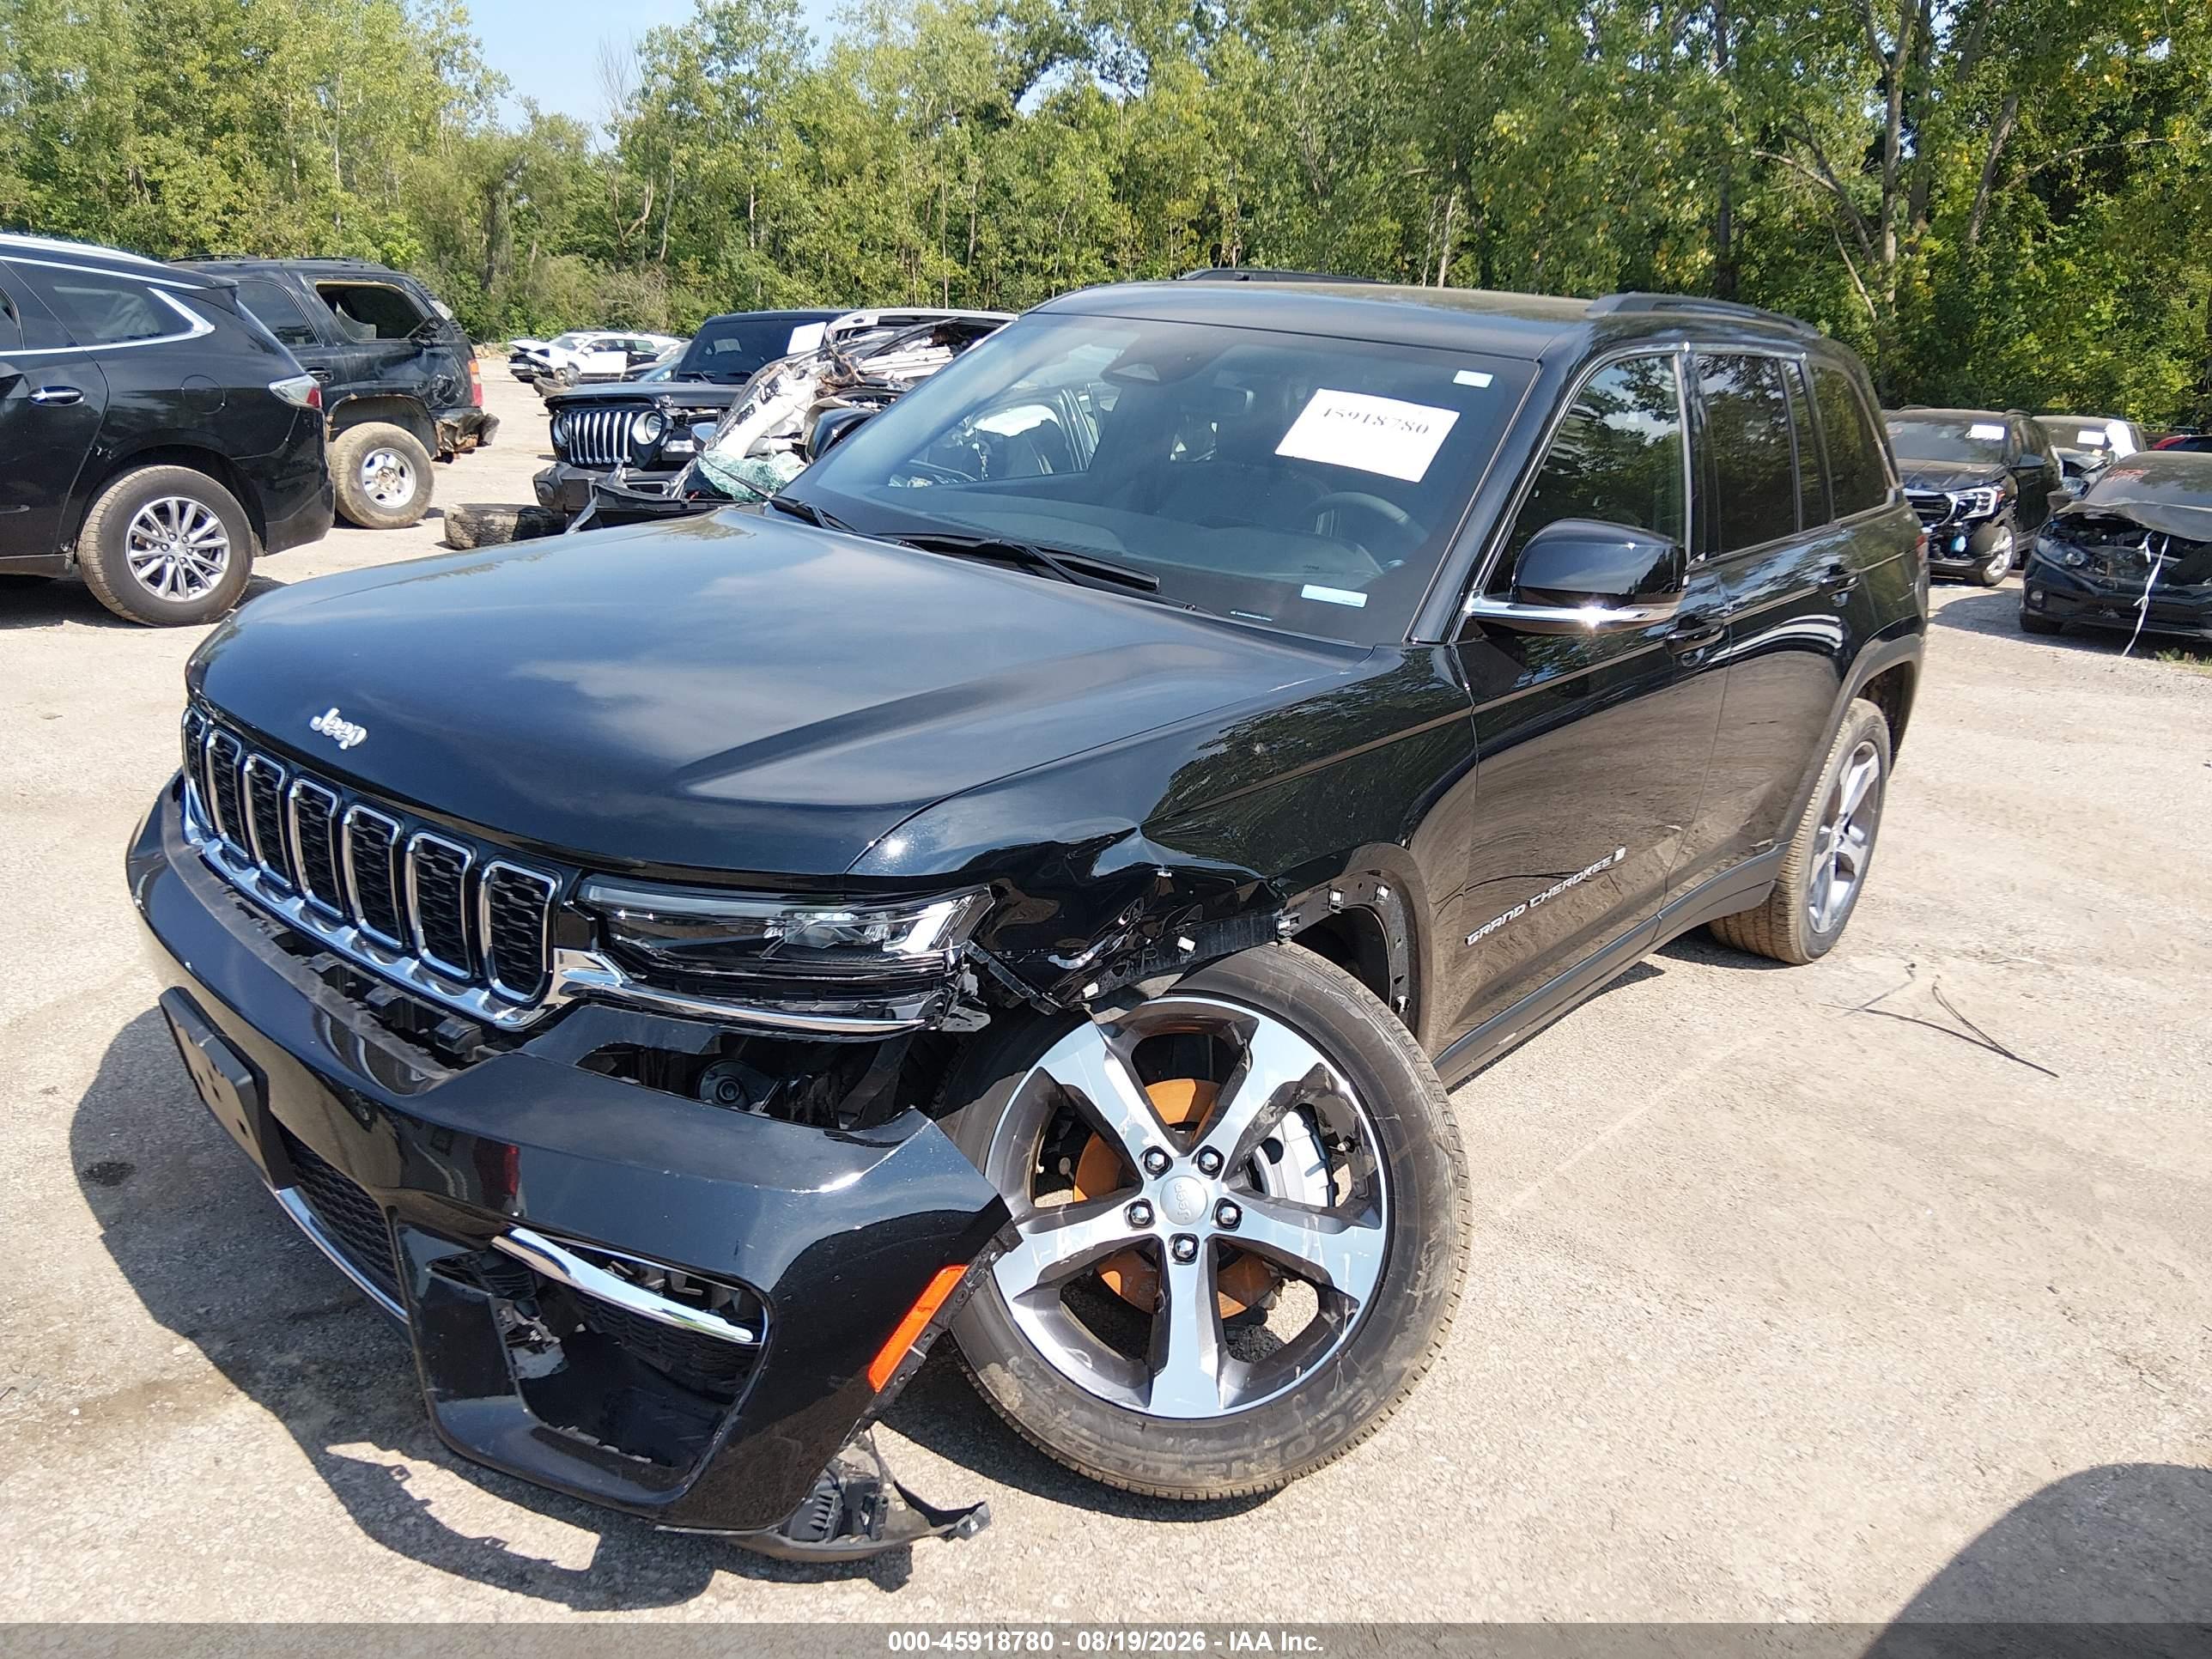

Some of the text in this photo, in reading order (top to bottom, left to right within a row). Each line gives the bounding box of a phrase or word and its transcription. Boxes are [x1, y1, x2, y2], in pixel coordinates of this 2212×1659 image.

[309, 708, 368, 750] Jeep
[1465, 854, 1613, 945] GRAND CHEROKEE
[1174, 1182, 1192, 1220] Jeep
